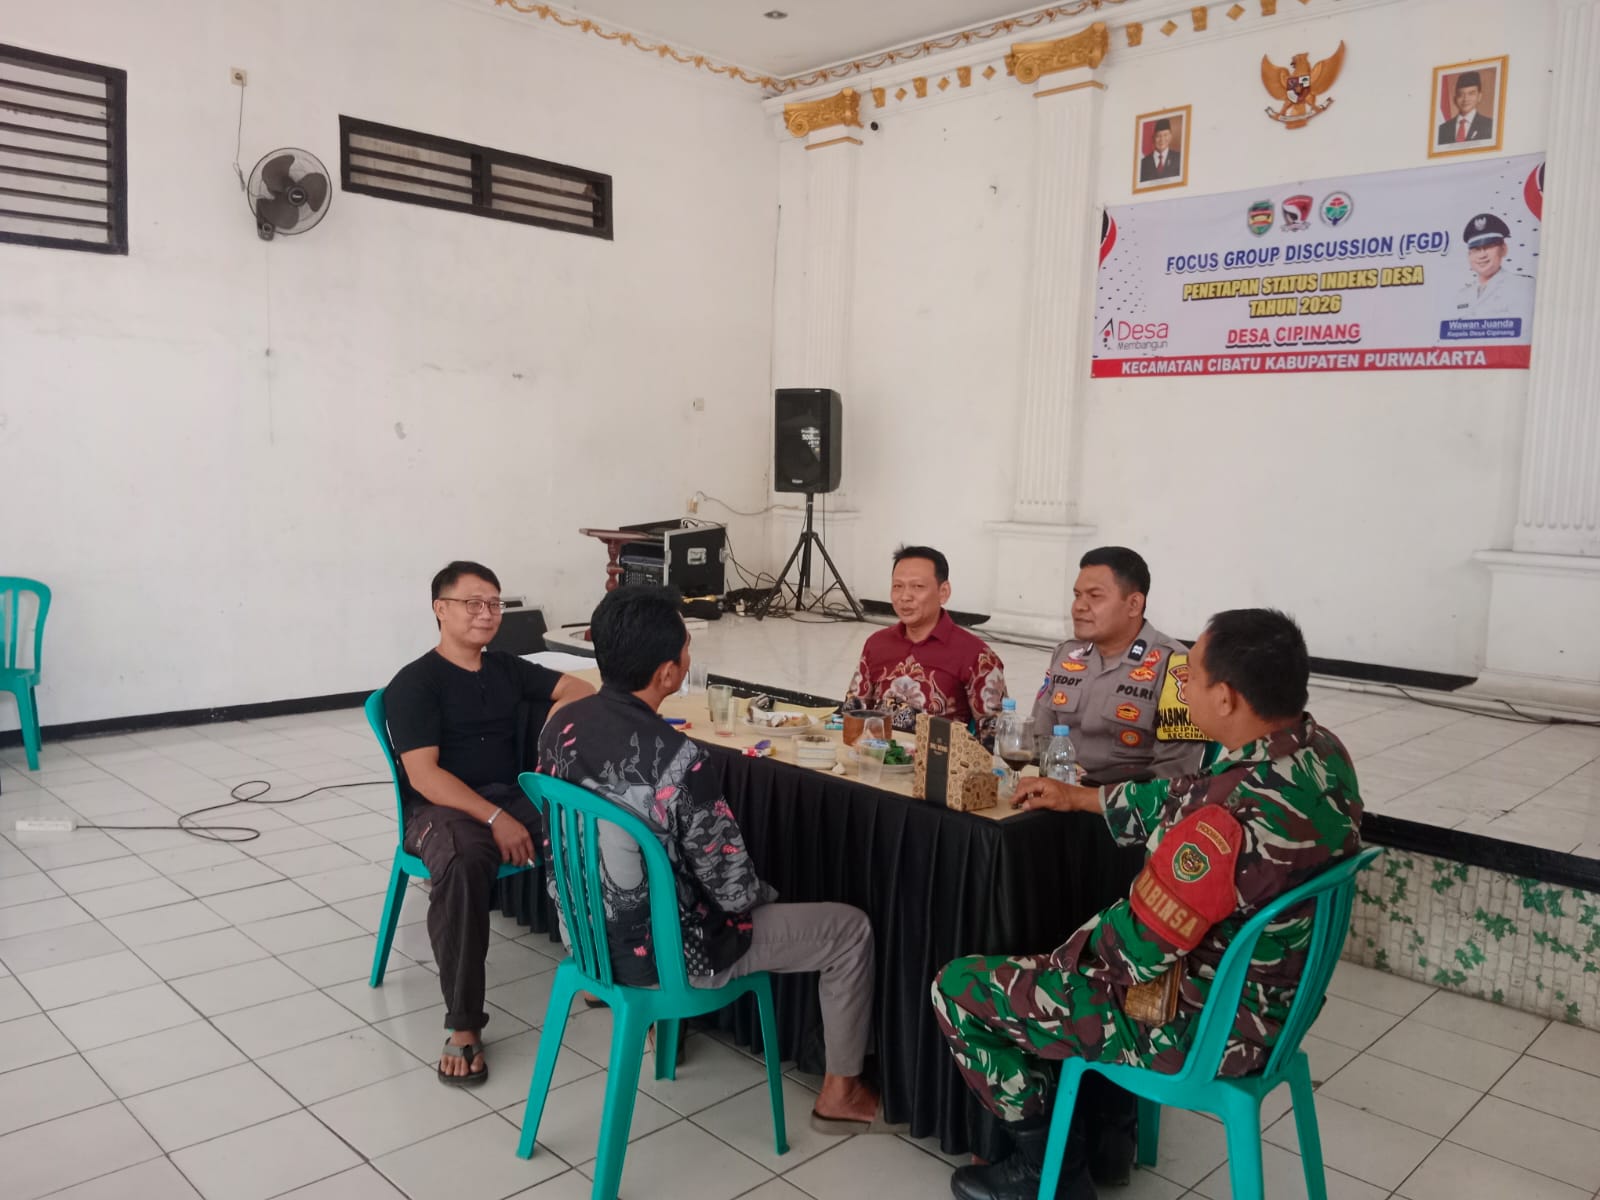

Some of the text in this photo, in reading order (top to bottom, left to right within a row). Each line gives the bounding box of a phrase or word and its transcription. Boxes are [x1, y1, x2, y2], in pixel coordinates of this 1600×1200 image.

[1166, 231, 1450, 273] FOCUS GROUP DISCUSSION (FGD)
[1183, 265, 1424, 301] PENETAPAN STATUS INDEKS DESA
[1249, 295, 1342, 318] TAHUN 2026
[1117, 320, 1169, 341] Desa
[1227, 323, 1361, 344] DESA CIPINANG
[1449, 319, 1514, 329] Wawan Juanda
[1118, 340, 1168, 351] Membangun
[1121, 350, 1487, 375] KECAMATAN CIBATU KABUPATEN PURWAKARTA
[1116, 684, 1154, 701] POLRI
